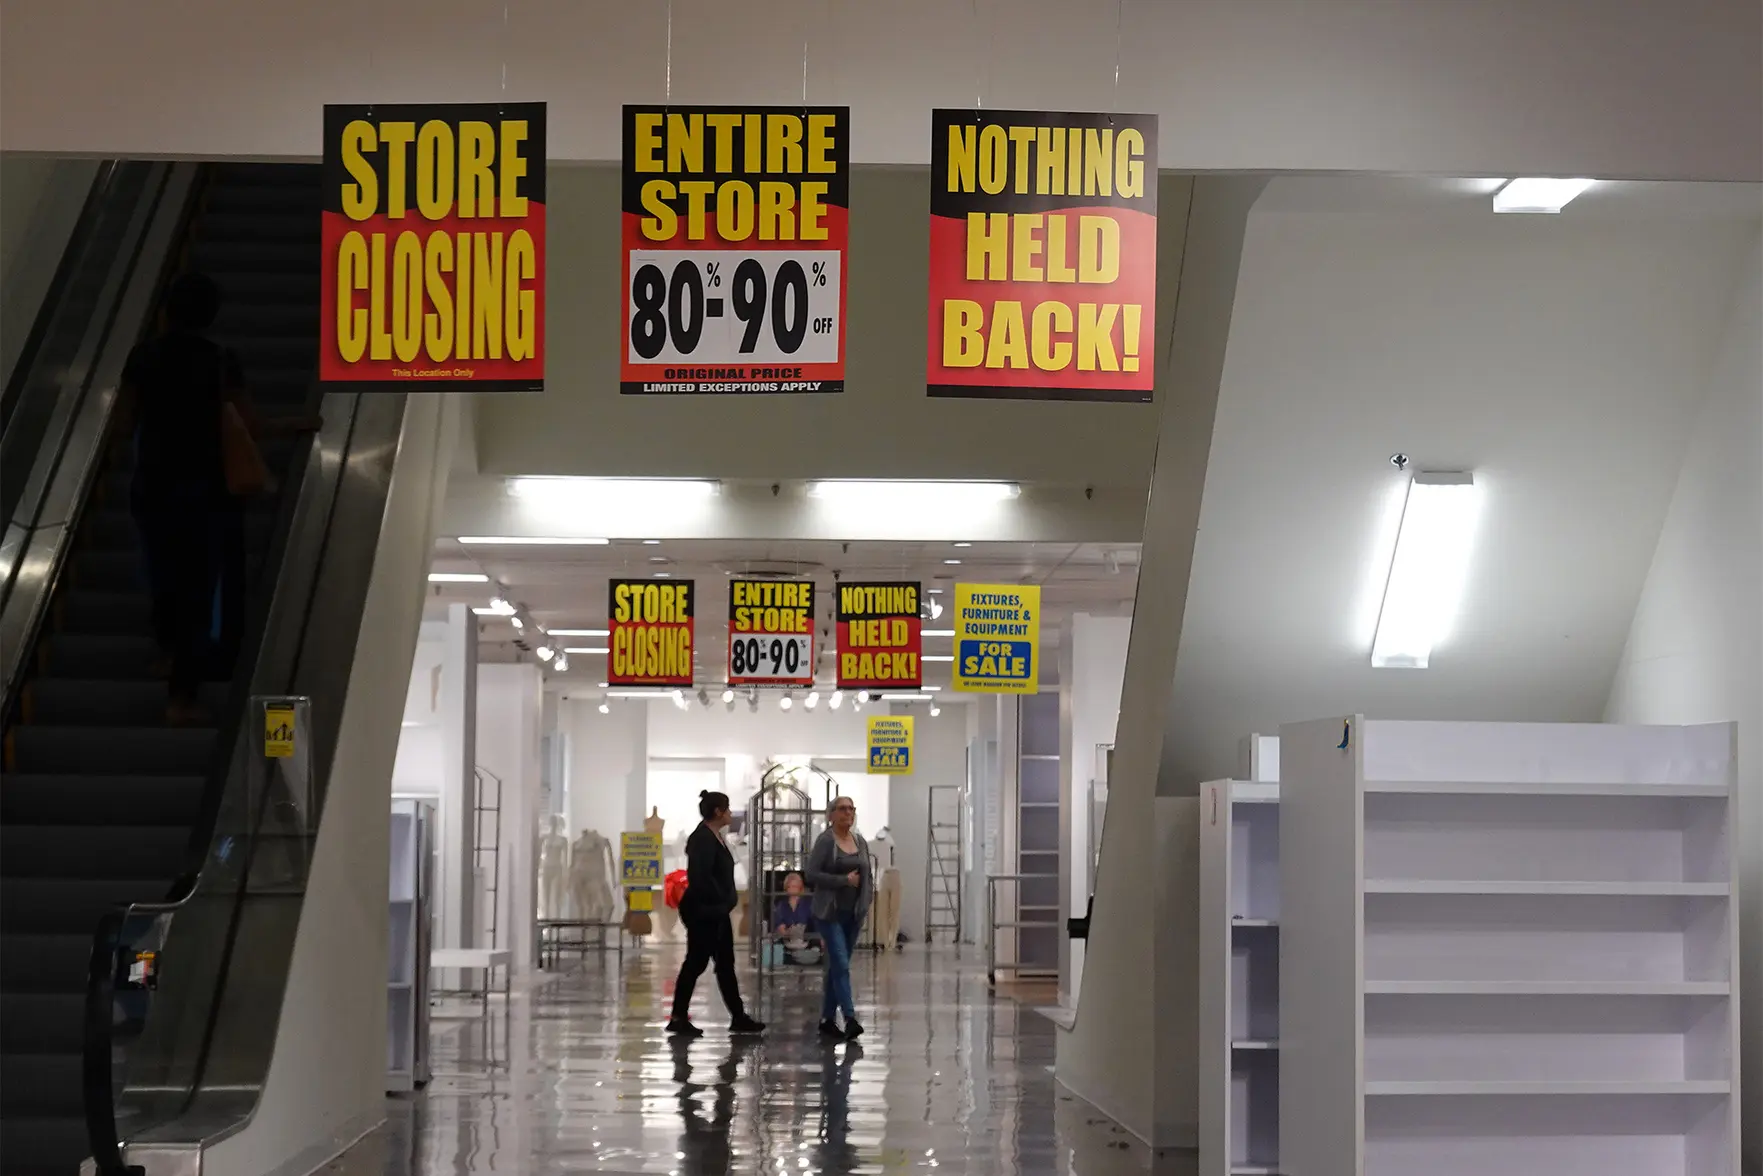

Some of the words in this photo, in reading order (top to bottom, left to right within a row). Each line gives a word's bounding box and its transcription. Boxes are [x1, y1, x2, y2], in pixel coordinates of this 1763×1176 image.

[635, 113, 836, 174] ENTIRE
[341, 119, 528, 221] STORE
[947, 124, 1145, 199] NOTHING
[640, 179, 828, 241] STORE
[966, 211, 1120, 284] HELD
[337, 229, 535, 363] CLOSING
[813, 317, 833, 334] OFF
[943, 299, 1142, 372] BACK!
[392, 368, 411, 377] This
[413, 368, 451, 377] Location
[453, 368, 474, 379] Only
[643, 383, 695, 392] LIMITED
[699, 382, 778, 392] EXCEPTIONS
[780, 382, 822, 391] APPLY
[664, 368, 746, 379] ORIGINAL
[751, 367, 802, 379] PRICE
[615, 584, 688, 623] STORE
[733, 582, 810, 607] ENTIRE
[841, 586, 917, 615] NOTHING
[971, 593, 1023, 608] FIXTURES,
[735, 607, 808, 632] STORE
[962, 608, 1018, 620] FURNITURE
[1023, 611, 1031, 621] &
[849, 619, 908, 647] HELD
[965, 622, 1028, 636] EQUIPMENT
[613, 626, 690, 677] CLOSING
[979, 643, 1012, 656] FOR
[841, 652, 917, 680] BACK!
[965, 656, 1025, 676] SALE
